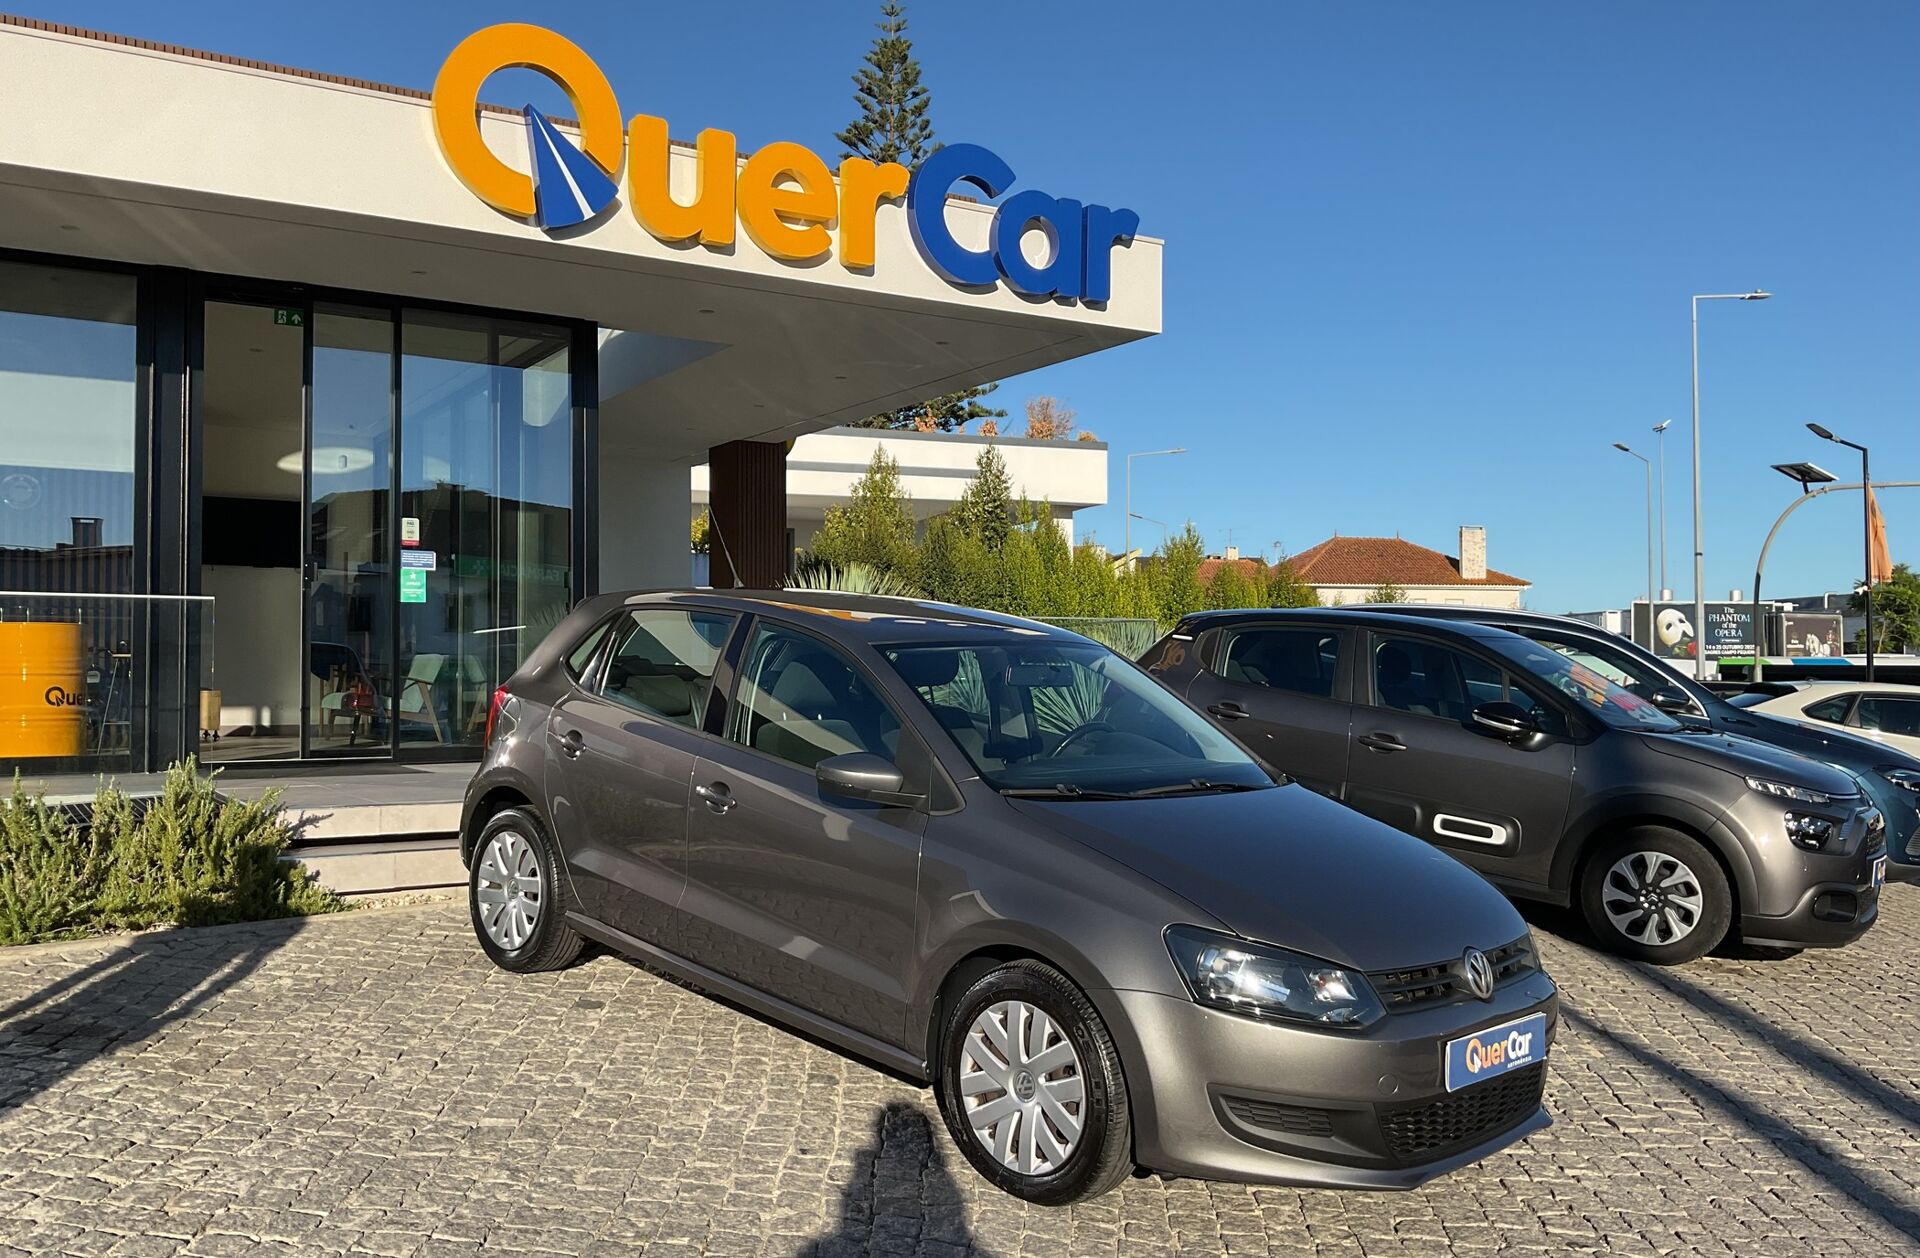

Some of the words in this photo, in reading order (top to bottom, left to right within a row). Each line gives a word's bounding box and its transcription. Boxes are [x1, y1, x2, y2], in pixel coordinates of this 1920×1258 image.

[432, 23, 1139, 305] QuerCar
[1708, 613, 1750, 622] PHANTOM
[1715, 628, 1743, 637] OPERA
[45, 685, 83, 707] Que
[1465, 1030, 1533, 1074] QuerCar
